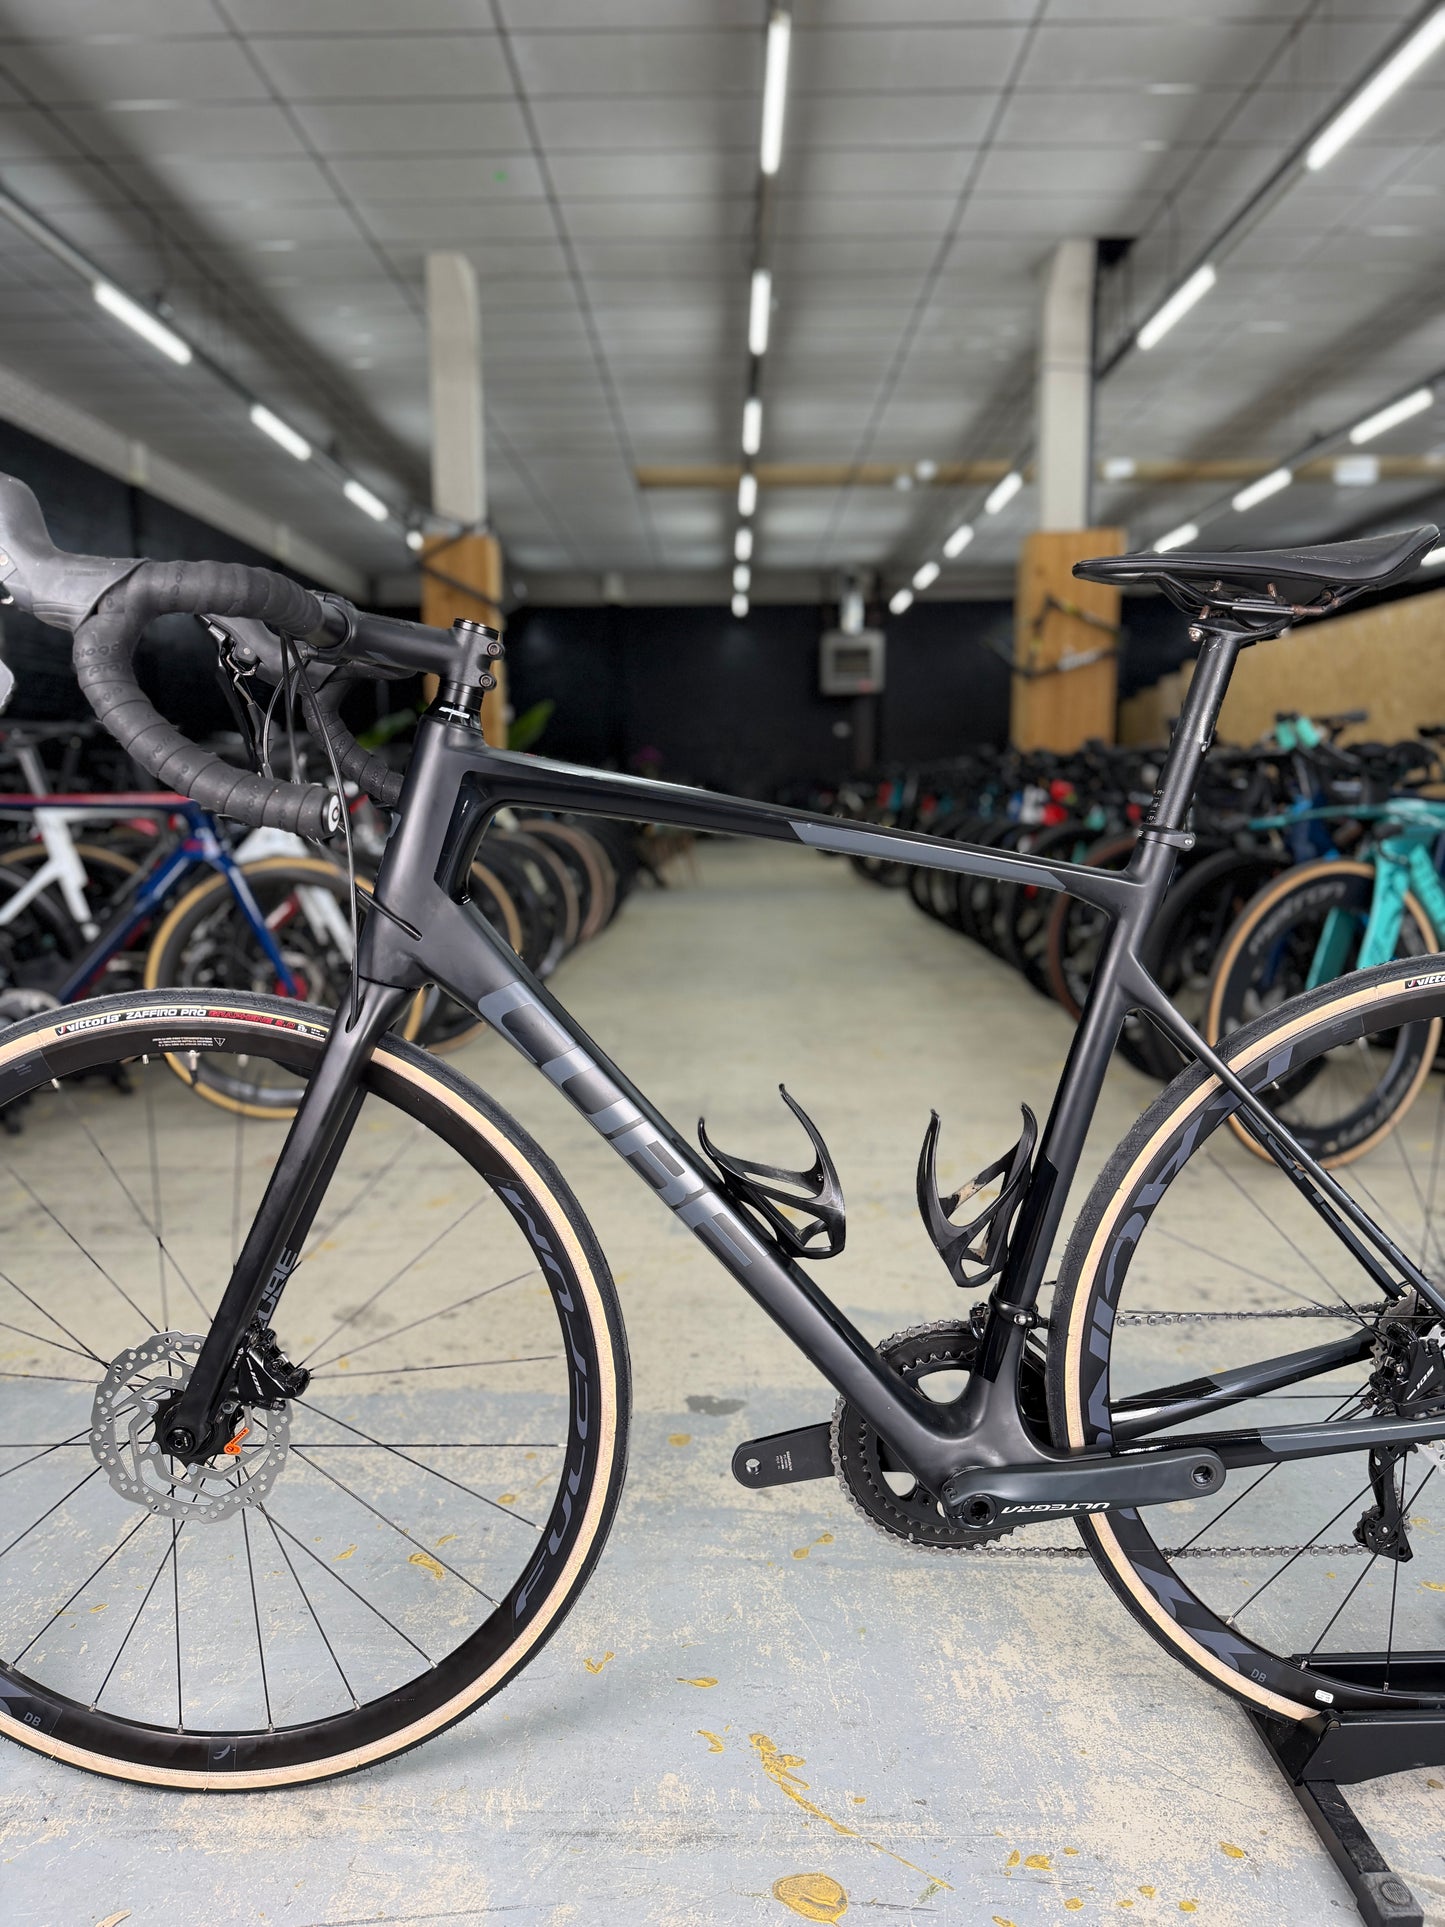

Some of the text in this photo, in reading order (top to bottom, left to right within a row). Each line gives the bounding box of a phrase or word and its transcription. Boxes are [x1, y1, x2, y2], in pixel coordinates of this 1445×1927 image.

[65, 1013, 120, 1030] vittoria
[126, 1009, 177, 1020] ZAFFIRO
[180, 1009, 207, 1017] PRO
[1416, 1365, 1435, 1390] 105
[1001, 1502, 1111, 1514] ULTEGRA
[1250, 1667, 1268, 1684] DB
[23, 1711, 42, 1727] DB
